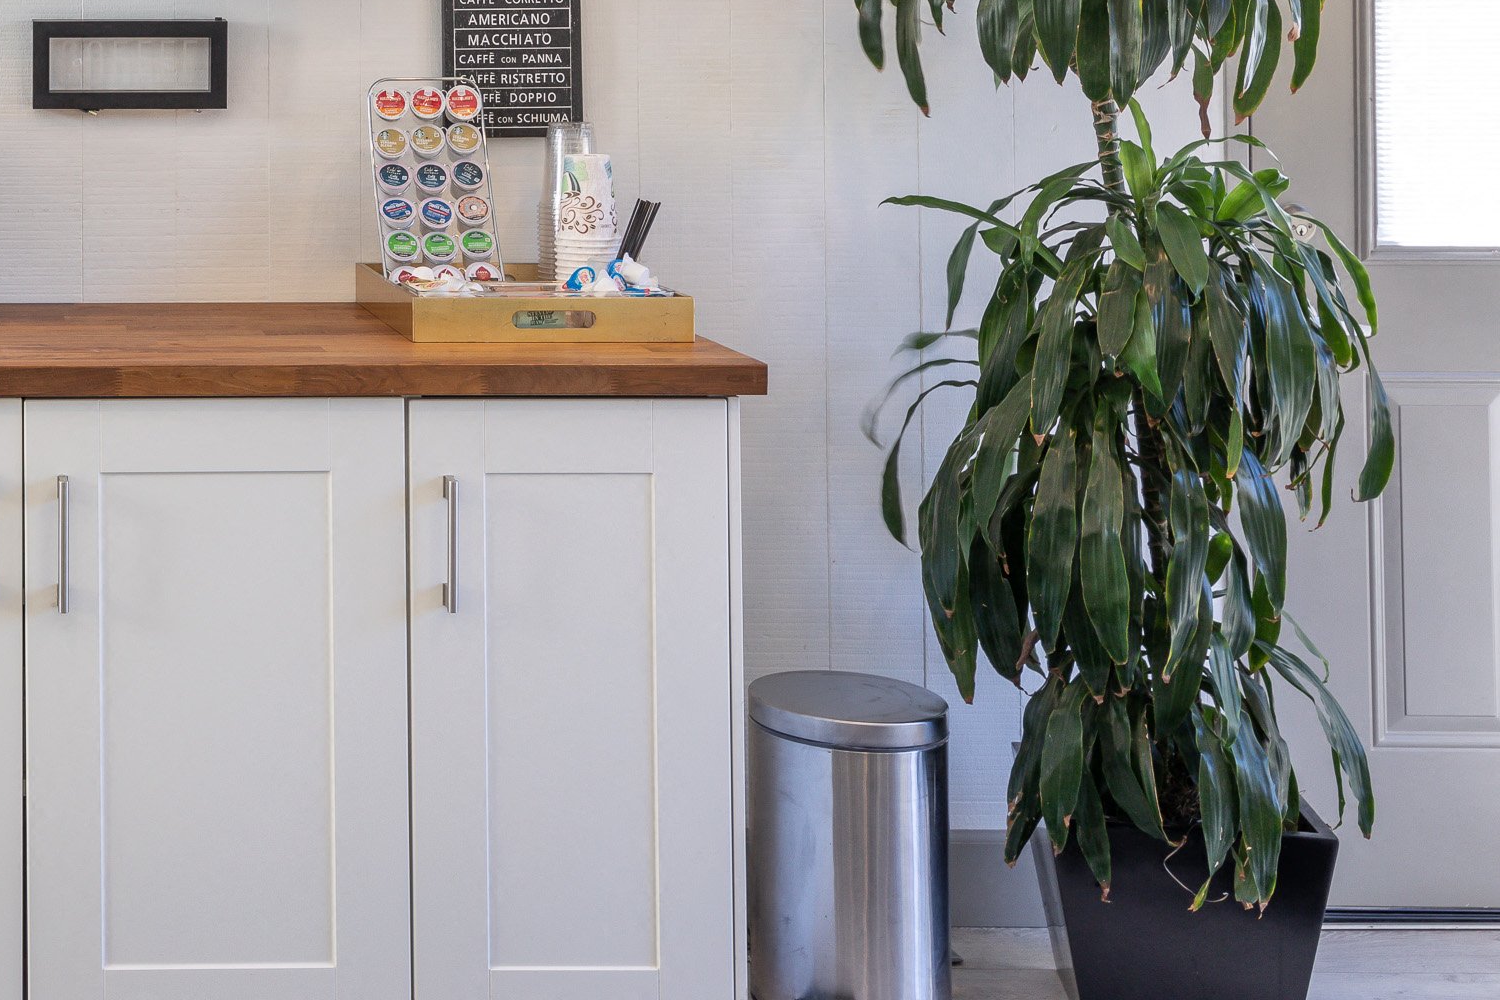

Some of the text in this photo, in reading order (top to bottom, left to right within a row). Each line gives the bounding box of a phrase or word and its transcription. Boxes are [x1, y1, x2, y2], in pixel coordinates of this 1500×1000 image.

[468, 13, 550, 25] AMERICANO
[468, 33, 552, 45] MACCHIATO
[459, 52, 495, 64] CAFFÈ
[522, 53, 563, 63] PANNA
[460, 72, 566, 84] CAFFÈ RISTRETTO
[482, 91, 557, 103] FFÈ DOPPIO
[466, 111, 494, 124] AFFÈ
[516, 113, 569, 123] SCHIUMA
